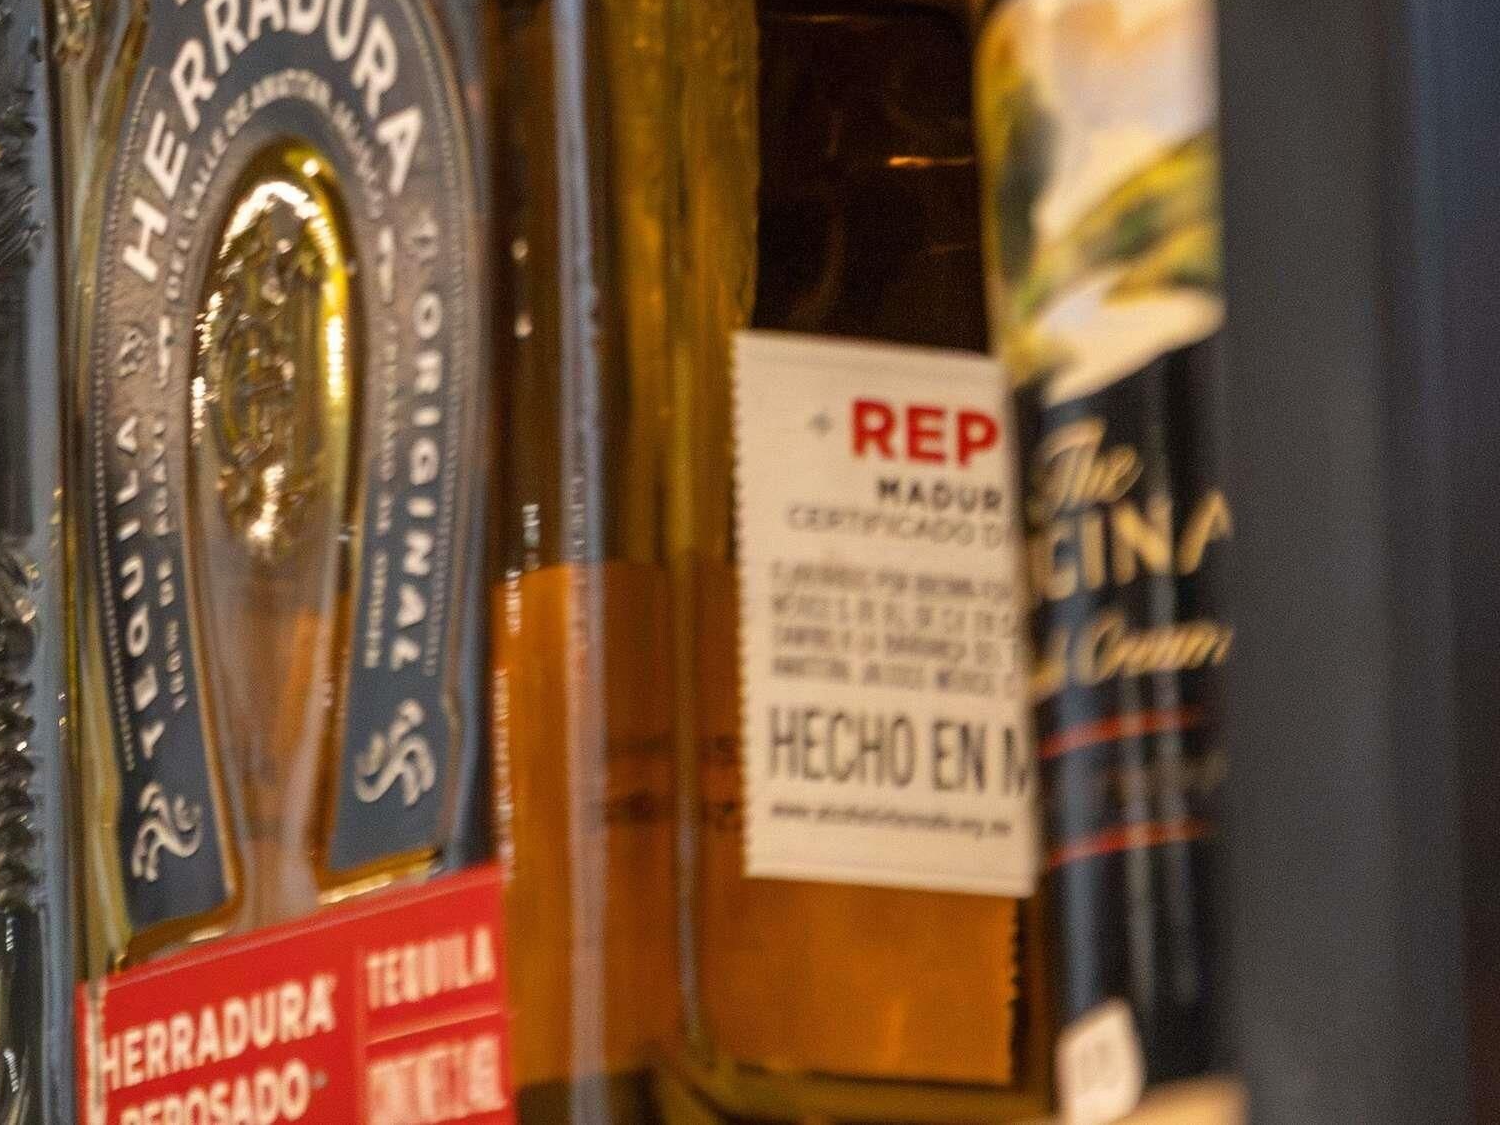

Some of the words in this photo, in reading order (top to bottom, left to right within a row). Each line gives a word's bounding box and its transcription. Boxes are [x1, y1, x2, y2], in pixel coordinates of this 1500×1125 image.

[388, 290, 444, 673] ORIGINAL
[850, 398, 1001, 469] REP
[116, 415, 166, 759] TEQUILA
[769, 706, 915, 789] HECHO
[931, 720, 988, 793] EN
[102, 978, 336, 1091] HERRADURA
[120, 1059, 311, 1125] POSADO
